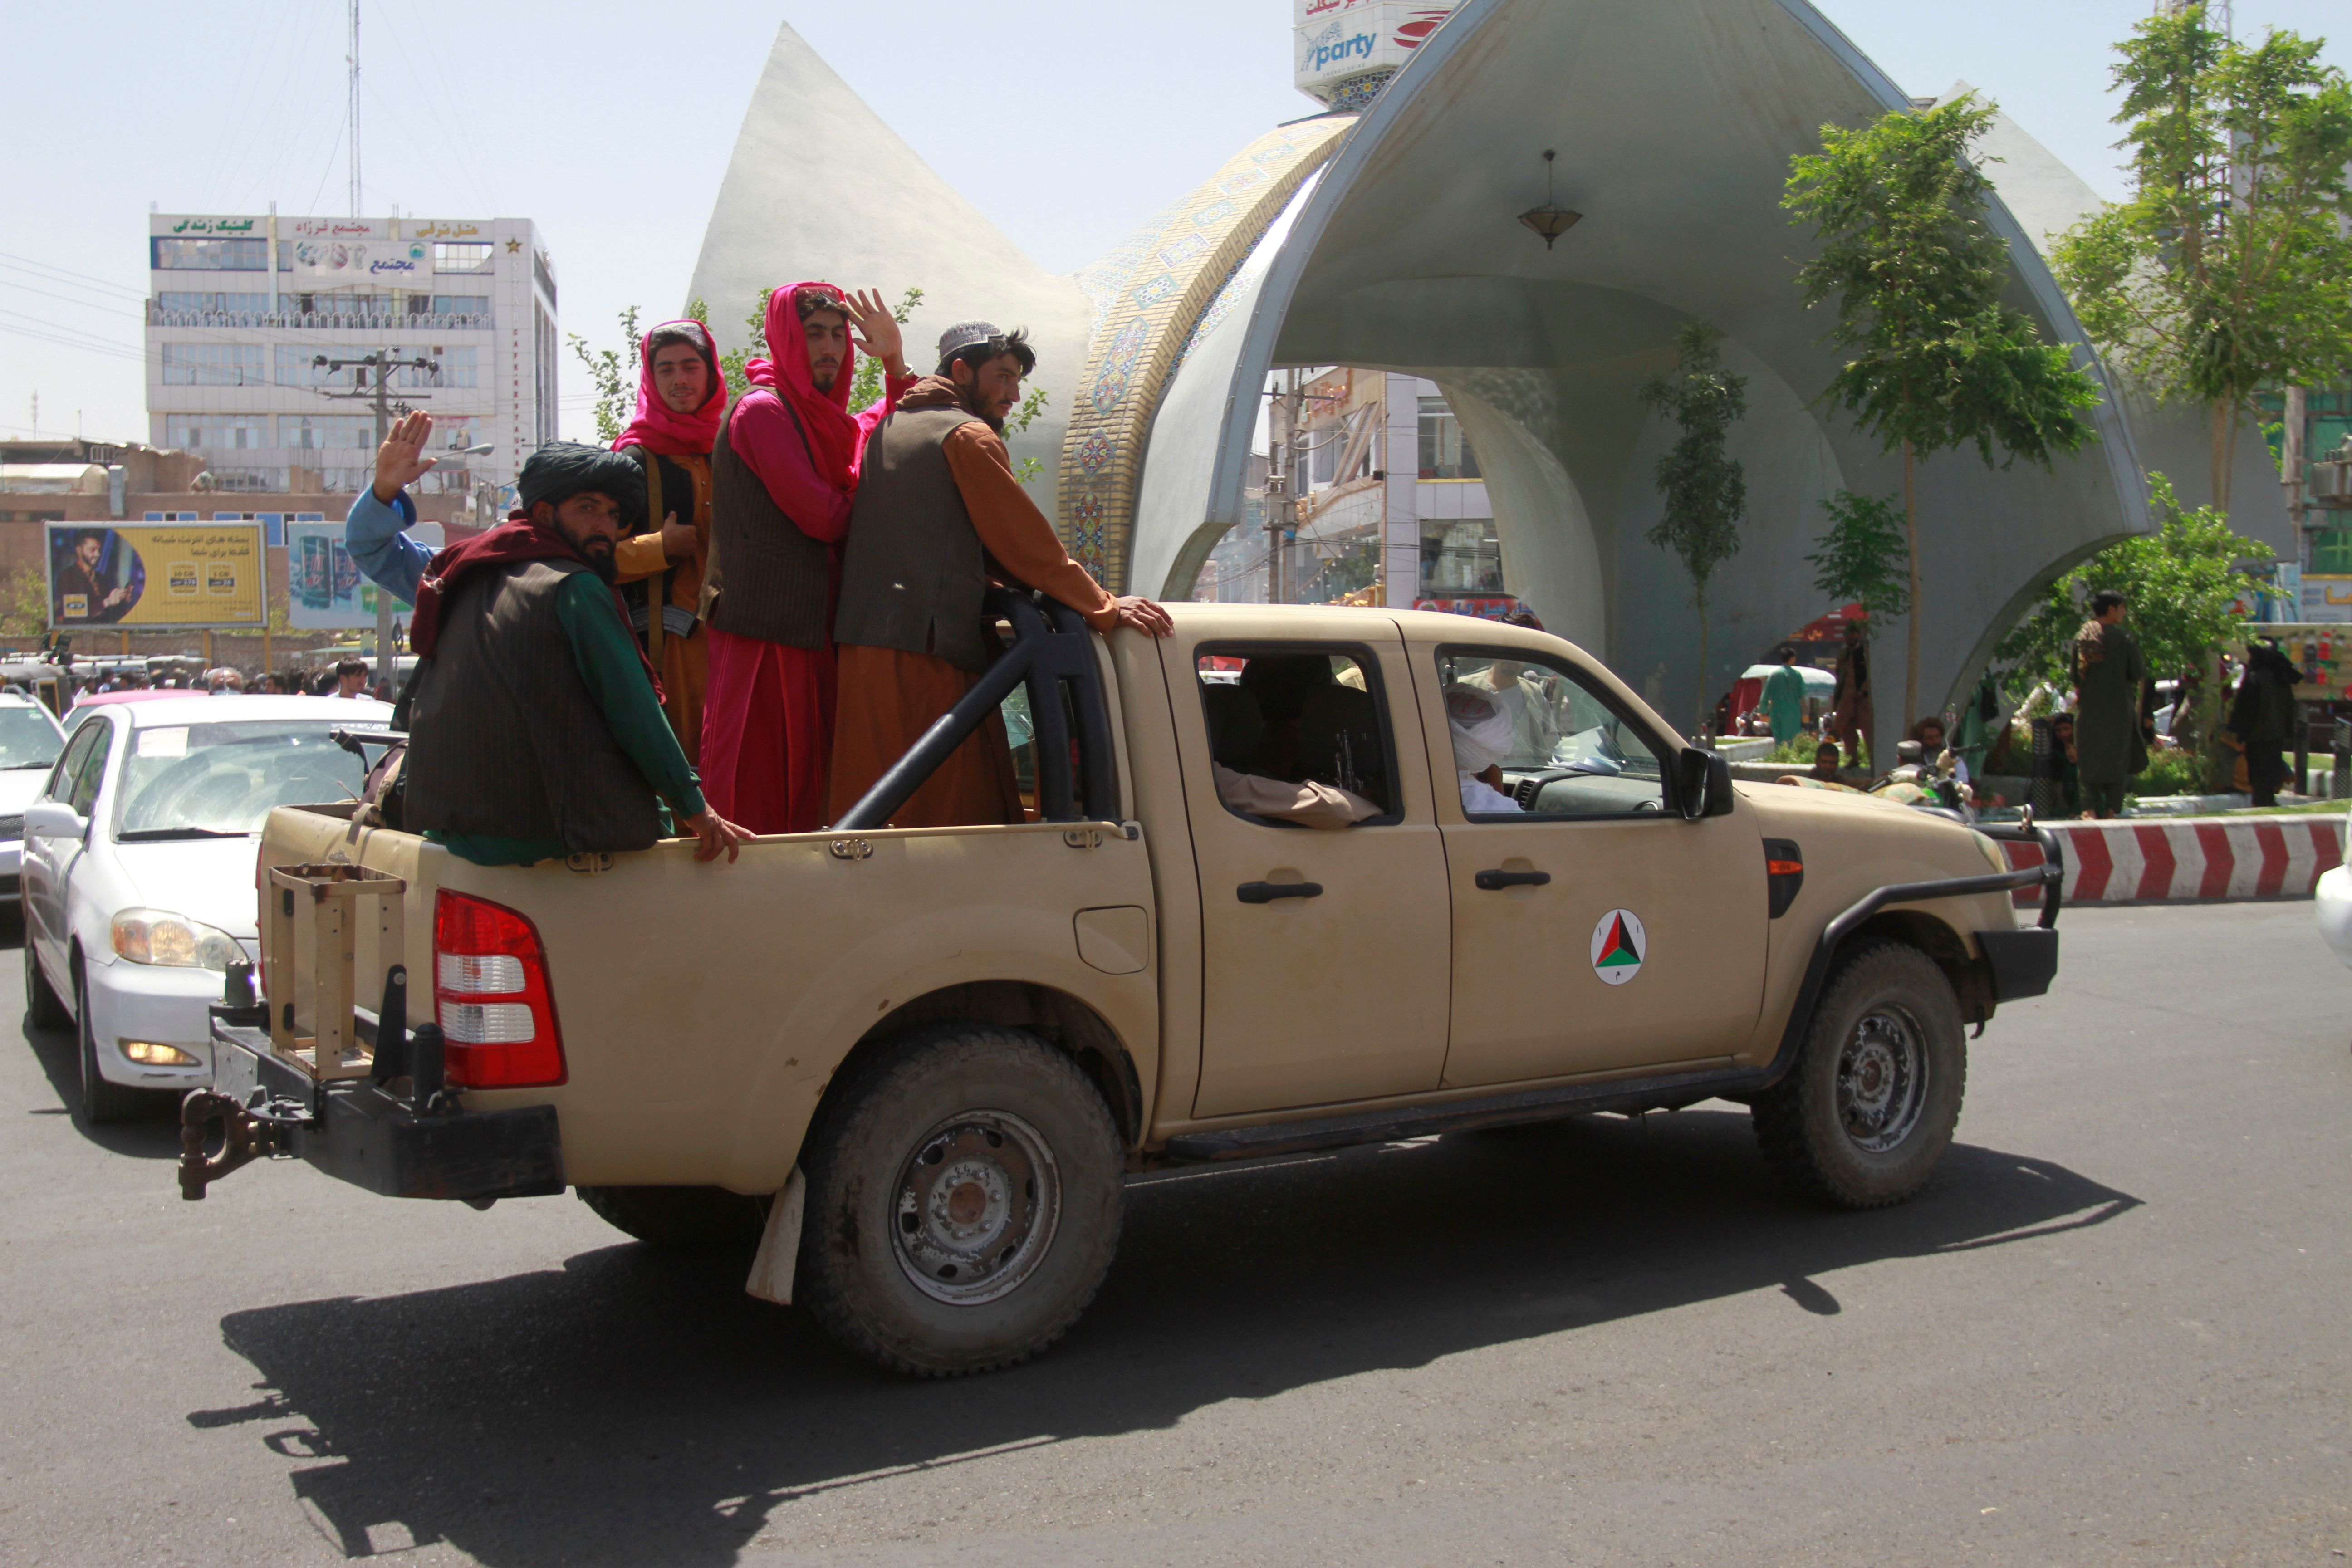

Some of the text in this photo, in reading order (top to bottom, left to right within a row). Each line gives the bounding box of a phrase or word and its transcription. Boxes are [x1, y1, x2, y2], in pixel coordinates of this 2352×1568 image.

[1316, 33, 1377, 71] party
[332, 222, 371, 236] مجتمع
[452, 224, 478, 237] هتل
[370, 258, 415, 274] مجتمع
